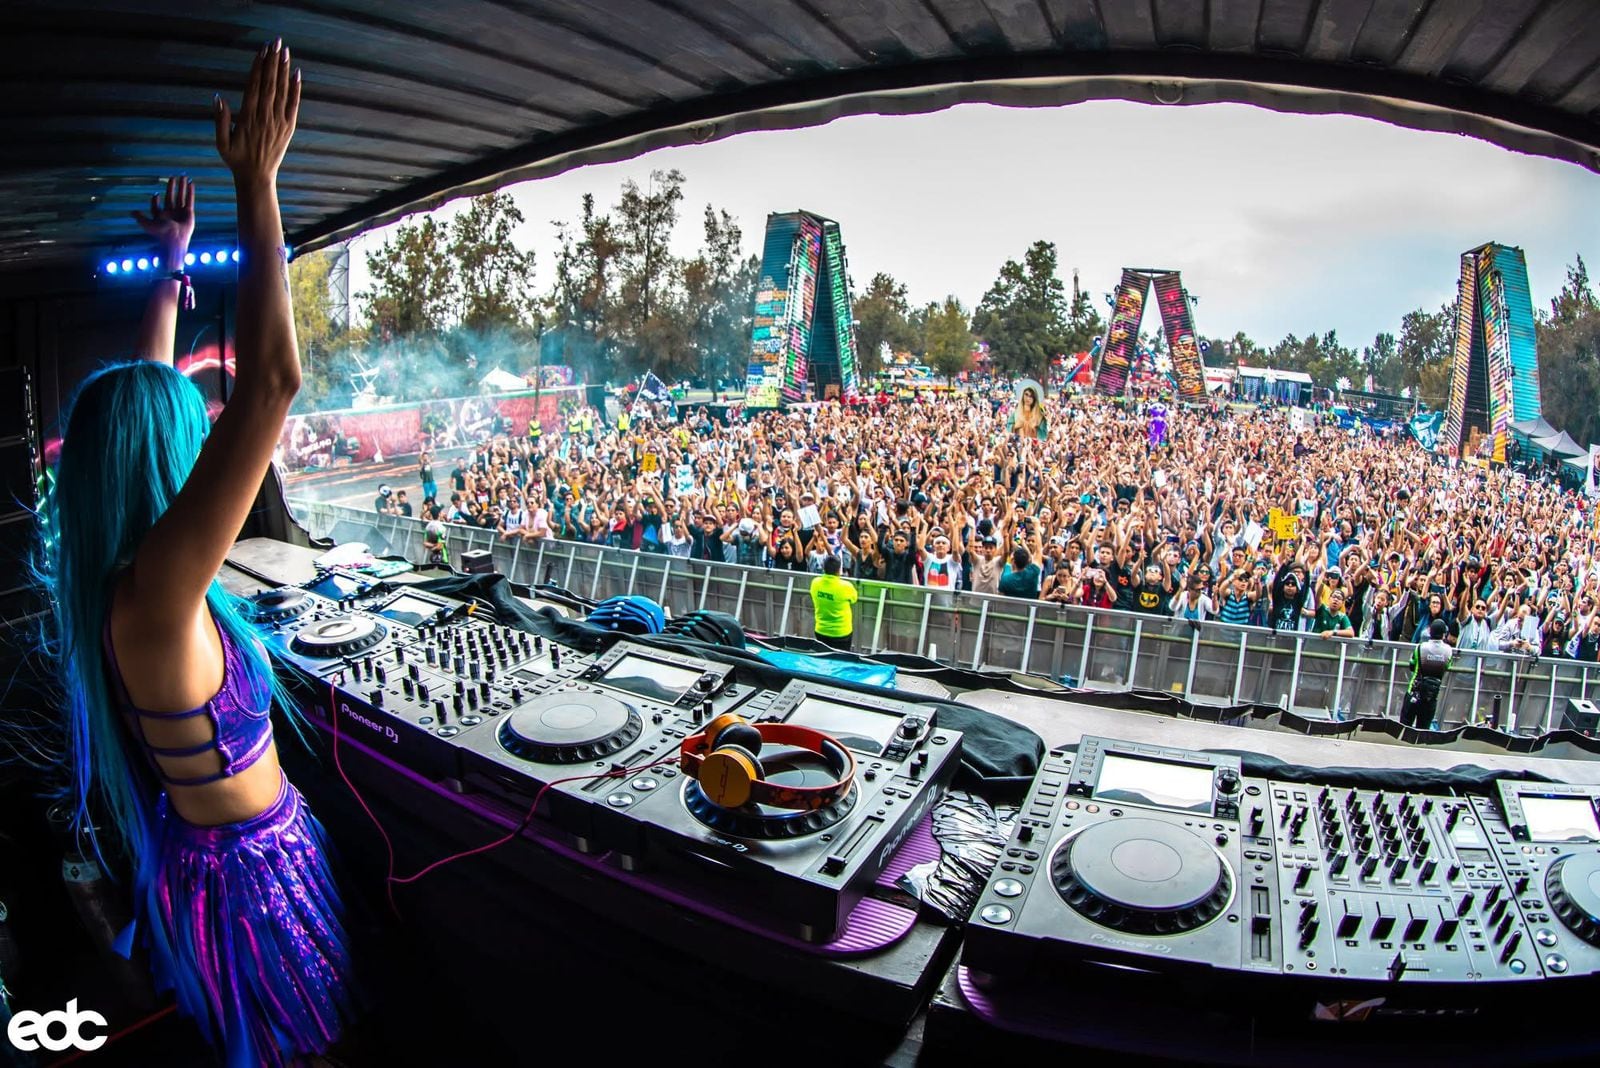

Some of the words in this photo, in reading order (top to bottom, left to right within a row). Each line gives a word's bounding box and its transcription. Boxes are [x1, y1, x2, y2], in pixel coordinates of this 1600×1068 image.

[341, 703, 383, 732] Pioneer
[385, 726, 398, 744] DJ
[878, 800, 925, 868] Pioneer
